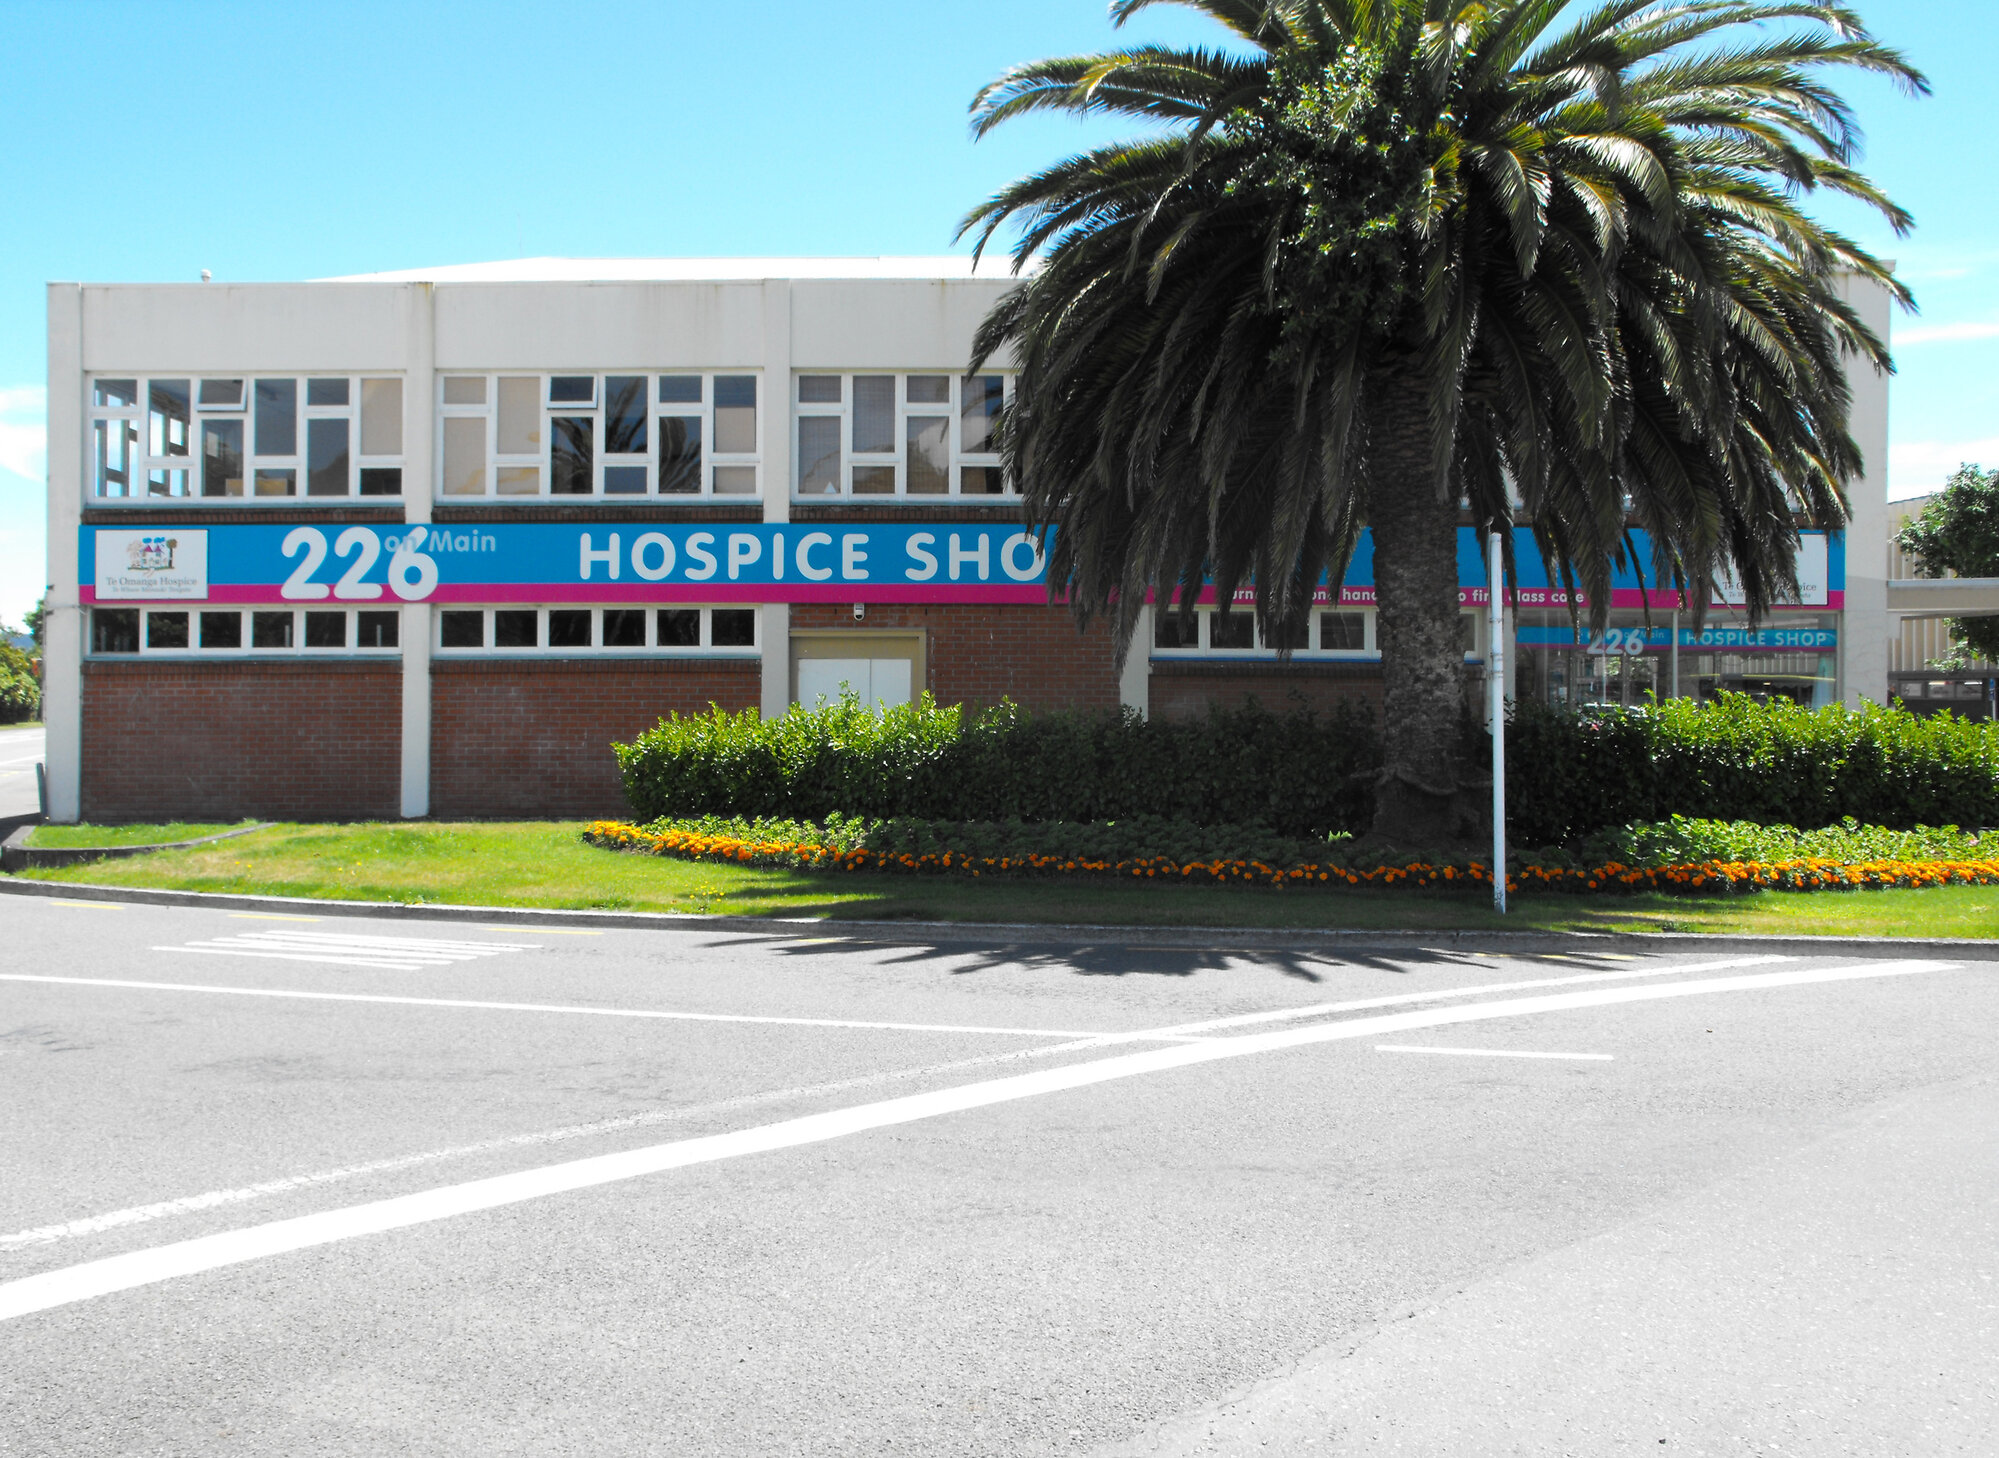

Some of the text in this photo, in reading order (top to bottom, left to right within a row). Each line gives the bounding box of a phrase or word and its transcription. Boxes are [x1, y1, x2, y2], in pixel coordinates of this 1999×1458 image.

[384, 529, 496, 552] on Main
[280, 526, 439, 601] 226
[579, 532, 1046, 582] HOSPICE SHO
[106, 576, 198, 588] Te Omanga Hospice
[1508, 589, 1545, 603] lass
[1551, 592, 1584, 603] cae
[1586, 628, 1644, 656] 226
[1685, 631, 1827, 646] HOSPICE SHOP
